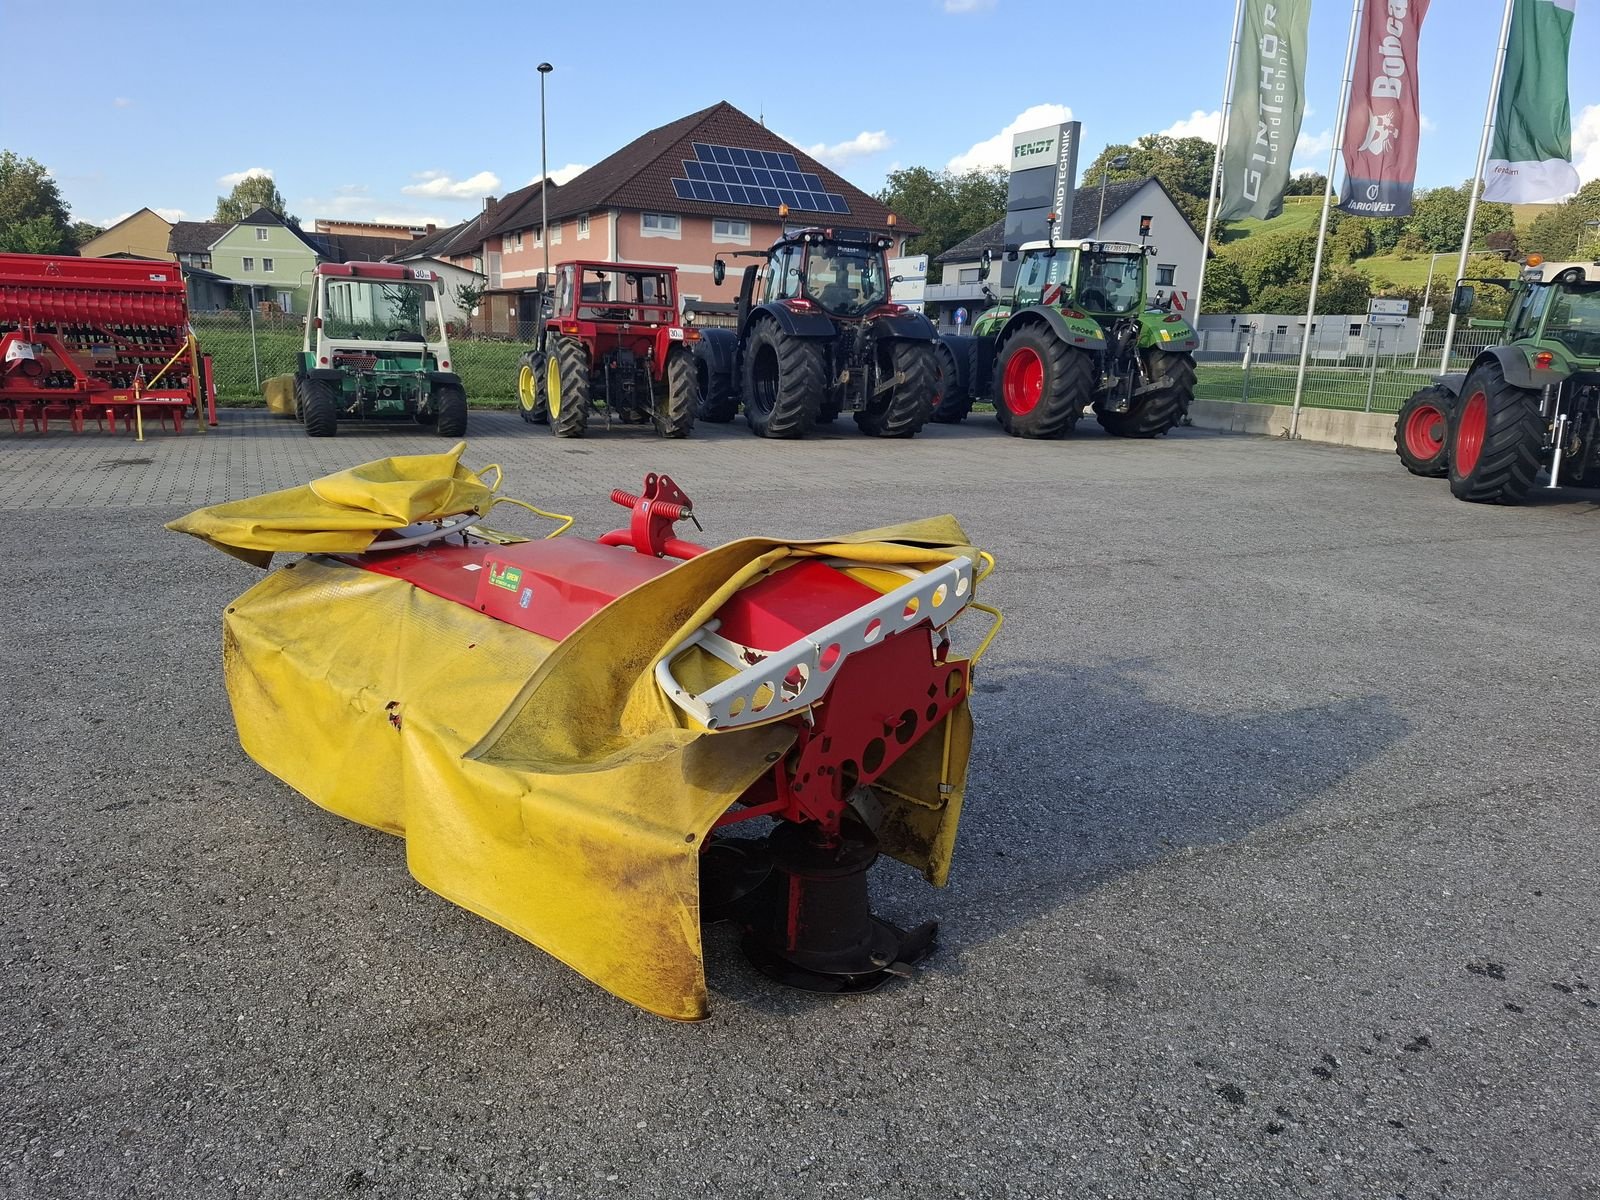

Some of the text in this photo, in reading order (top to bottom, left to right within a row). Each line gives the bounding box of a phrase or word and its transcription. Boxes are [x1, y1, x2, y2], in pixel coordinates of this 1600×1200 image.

[1243, 3, 1282, 202] GINTHÖR
[1014, 139, 1055, 158] FENDT
[1056, 129, 1071, 223] LANDTECHNIK
[415, 270, 424, 278] 30
